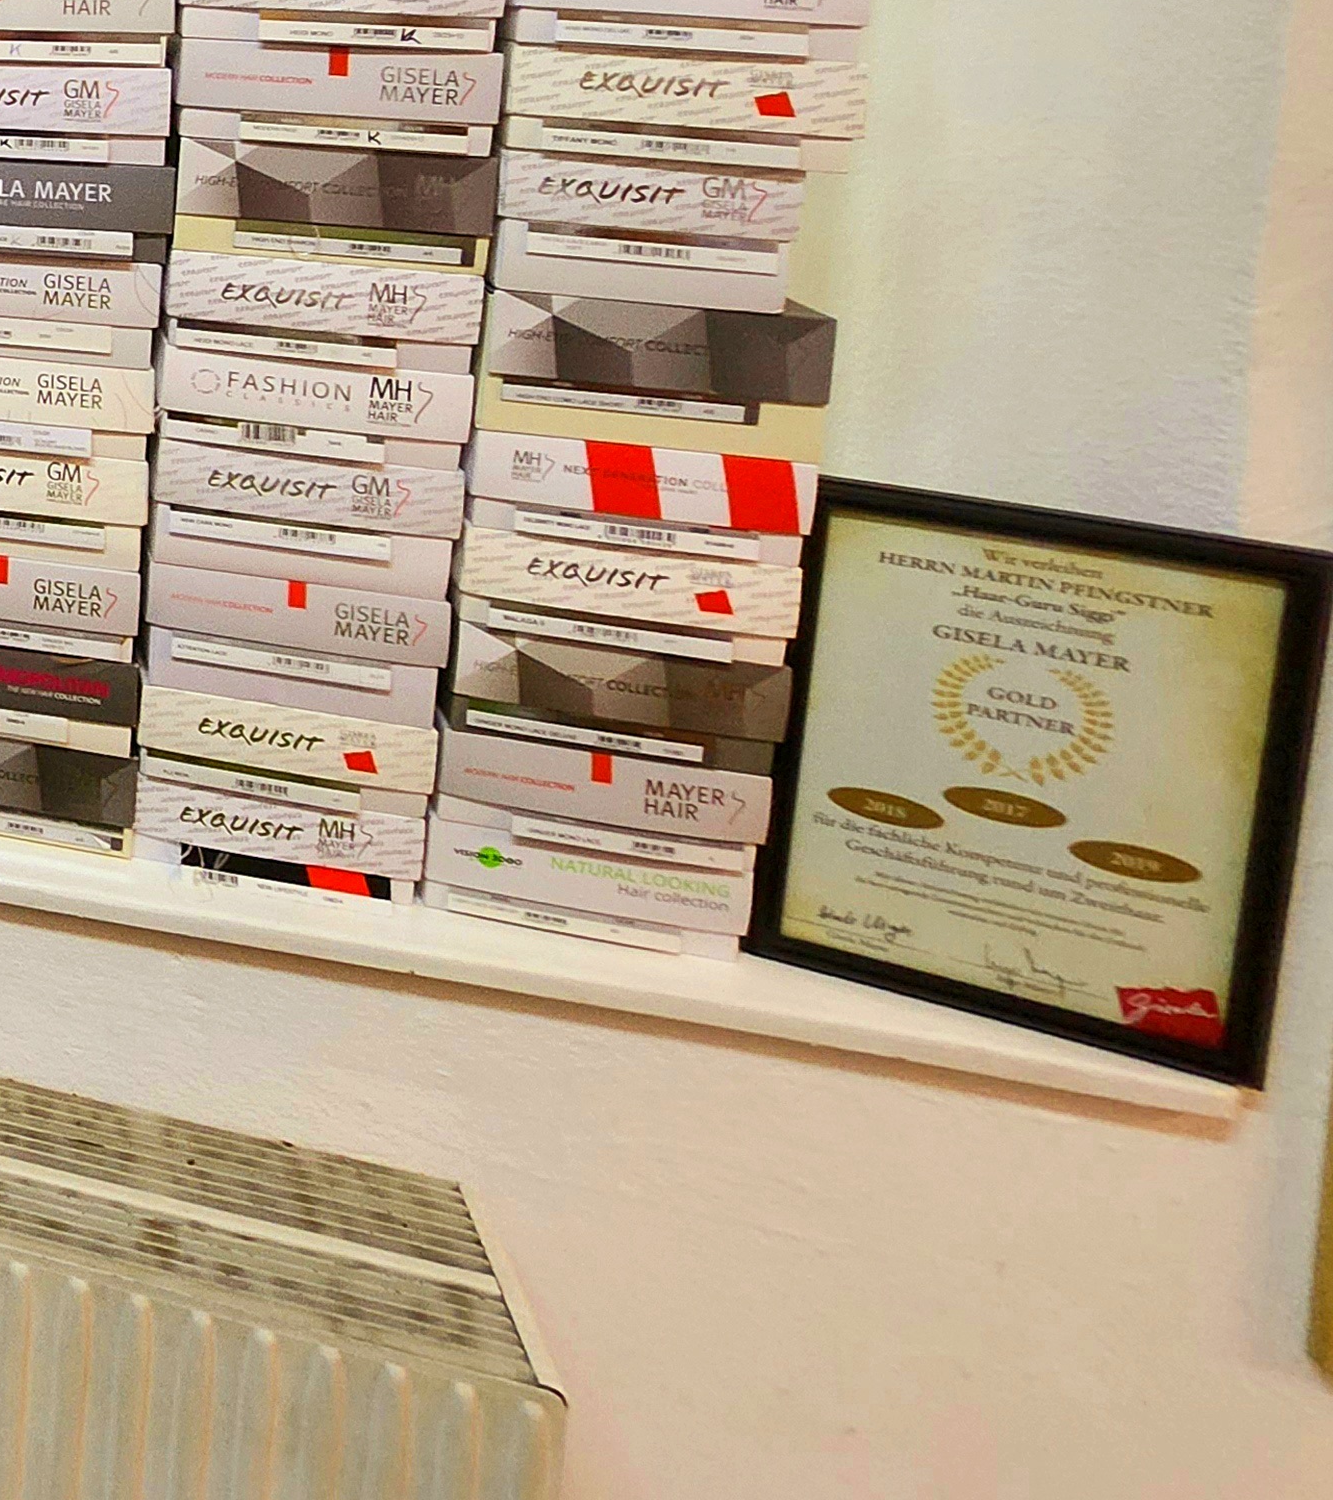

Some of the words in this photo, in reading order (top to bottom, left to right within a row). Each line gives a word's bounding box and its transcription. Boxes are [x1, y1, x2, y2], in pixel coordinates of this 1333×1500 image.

[63, 0, 111, 16] HAIR
[380, 66, 460, 87] GISELA
[579, 71, 731, 98] EXQUISIT
[64, 80, 100, 99] GM
[379, 84, 460, 106] MAYER
[552, 135, 588, 144] TIFFANY
[34, 181, 112, 202] MAYER
[538, 176, 686, 204] EXQUISIT
[43, 273, 111, 294] GISELA
[369, 282, 409, 304] MH
[43, 291, 111, 310] MAYER
[37, 374, 103, 394] GISELA
[227, 371, 352, 402] FASHION
[370, 377, 413, 402] MH
[37, 390, 103, 410] MAYER
[369, 400, 414, 413] MAYER
[367, 409, 398, 422] HAIR
[47, 462, 82, 484] GM
[564, 464, 599, 477] NEXT
[208, 469, 337, 499] EXQUISIT
[351, 475, 390, 497] GM
[983, 549, 1014, 567] Wir
[527, 558, 670, 590] EXQUISIT
[879, 551, 956, 575] HERRN
[962, 564, 1055, 591] MARTIN
[1059, 577, 1214, 618] PFINGSTNER
[33, 578, 102, 601] GISELA
[33, 596, 101, 618] MAYER
[335, 603, 410, 629] GISELA
[957, 605, 984, 619] die
[334, 620, 410, 647] MAYER
[933, 624, 1025, 654] GISELA
[1035, 642, 1130, 673] MAYER
[54, 692, 101, 706] COLLECTION
[988, 686, 1057, 711] GOLD
[966, 703, 1076, 736] PARTNER
[198, 717, 325, 751] EXQUISIT
[645, 779, 725, 806] MAYER
[644, 801, 699, 821] HAIR
[179, 806, 304, 841] EXQUISIT
[318, 818, 355, 841] MH
[551, 857, 635, 882] NATURAL
[642, 872, 730, 898] LOOKING
[617, 884, 648, 898] Hair
[654, 888, 730, 912] collection
